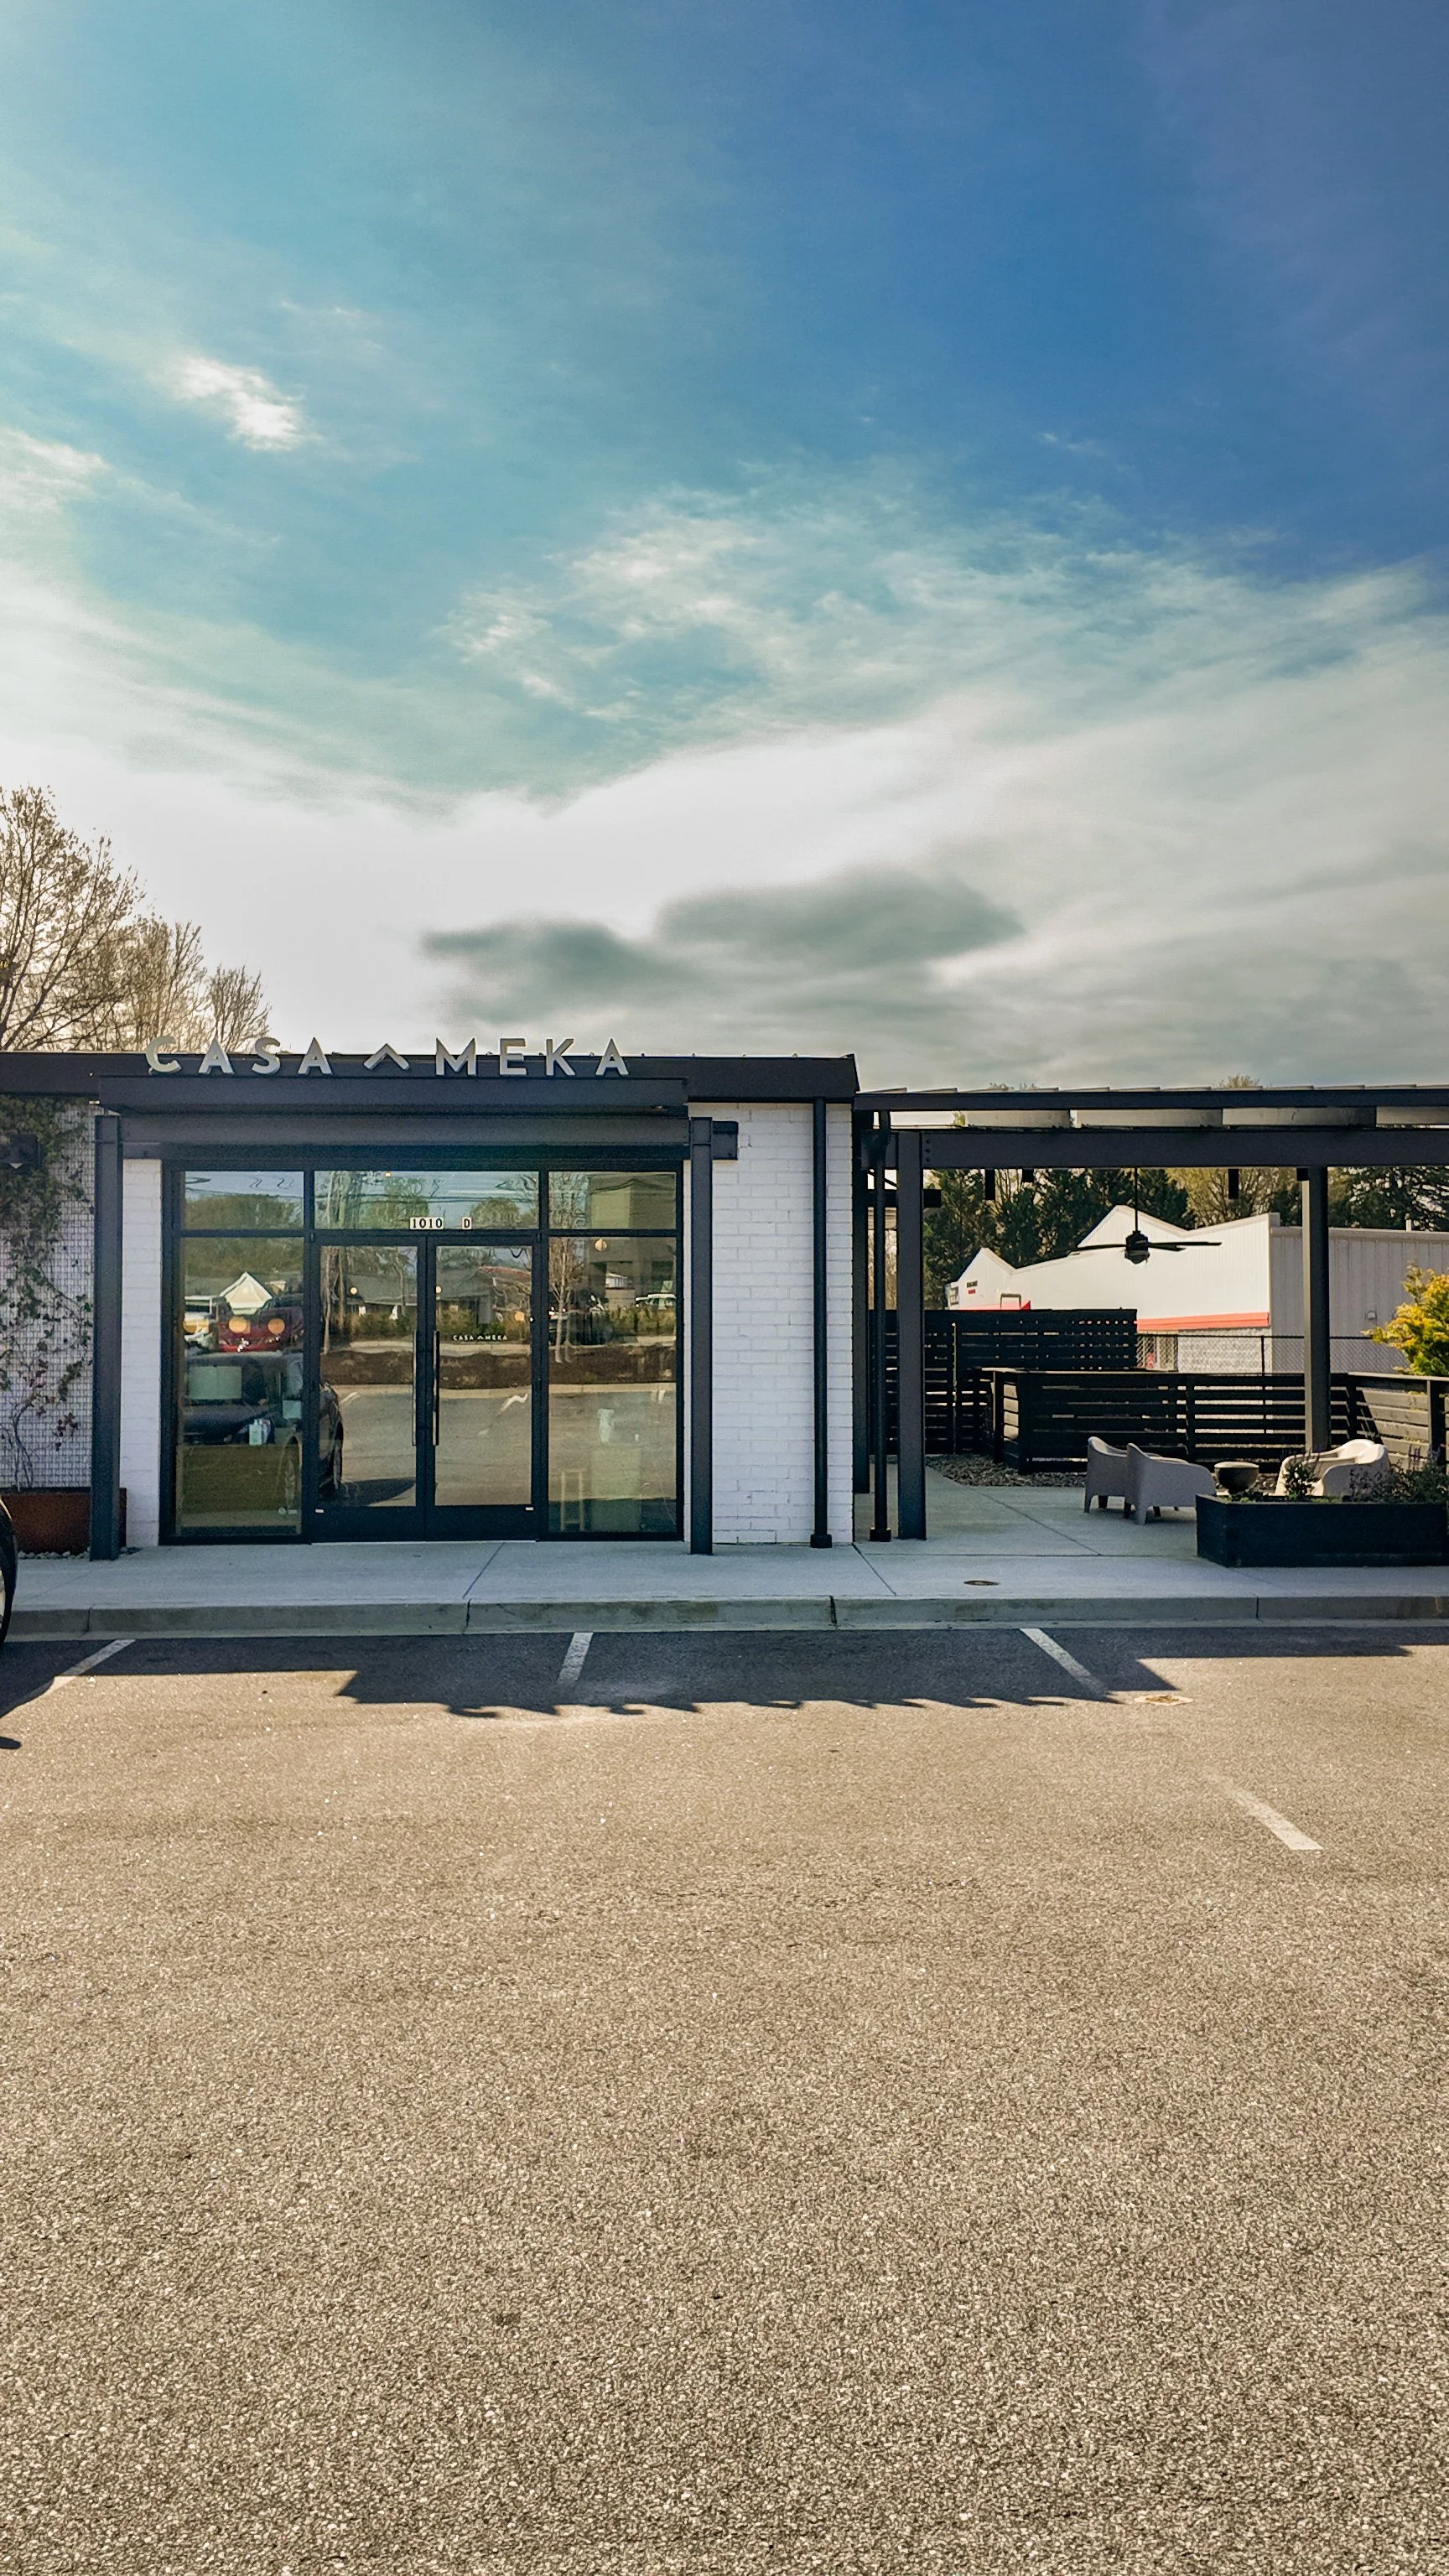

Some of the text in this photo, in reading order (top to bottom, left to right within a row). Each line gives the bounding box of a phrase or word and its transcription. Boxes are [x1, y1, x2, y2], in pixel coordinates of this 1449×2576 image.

[146, 1036, 629, 1076] CASA MEKA
[413, 1218, 470, 1228] 1010 D
